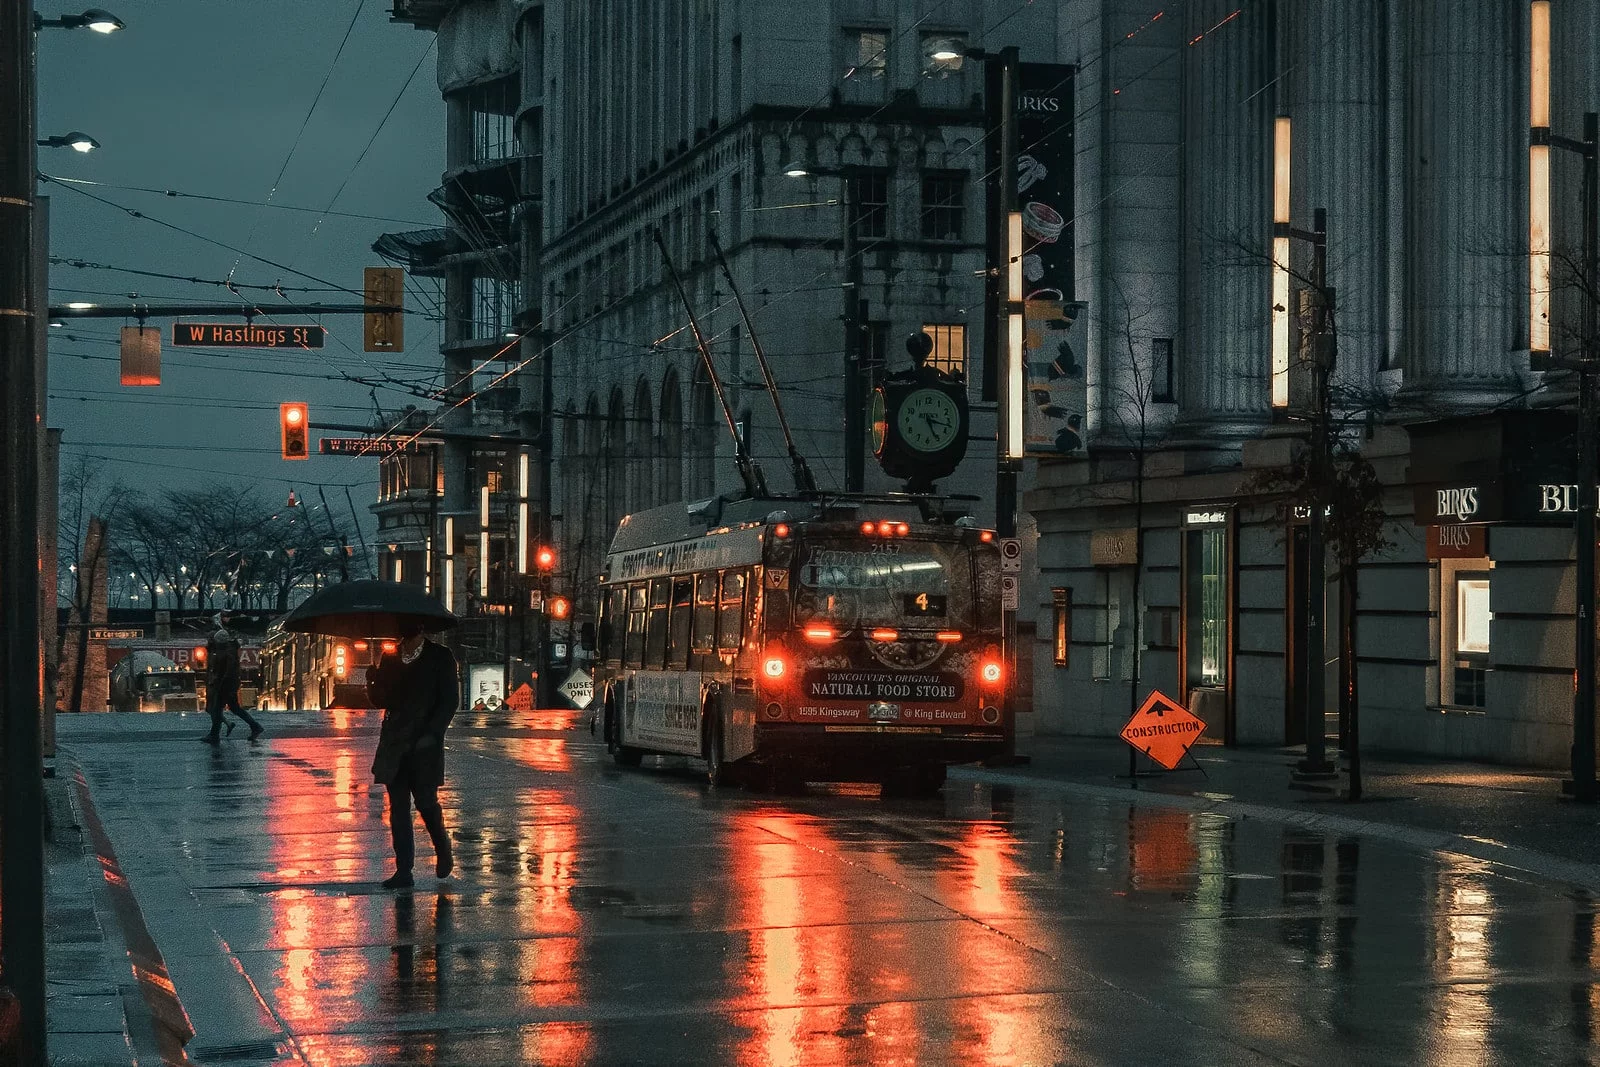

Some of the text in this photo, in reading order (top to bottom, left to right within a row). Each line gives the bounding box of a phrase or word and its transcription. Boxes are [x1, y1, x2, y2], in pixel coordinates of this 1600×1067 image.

[1017, 96, 1059, 112] IRKS
[190, 326, 308, 346] W Hastings St
[330, 439, 340, 450] W
[1436, 486, 1478, 521] BIRKS
[1439, 526, 1471, 551] BIRKS
[871, 543, 901, 555] 2157
[914, 592, 929, 611] 4
[567, 681, 593, 690] BUSES
[827, 673, 940, 684] VANCOUVER'S ORIGINAL
[571, 689, 592, 698] ONLY
[812, 683, 956, 698] NATURAL FOOD STORE
[799, 707, 966, 720] 1595 Kingsway @ King Edward
[1126, 721, 1200, 739] CONSTRUCTION
